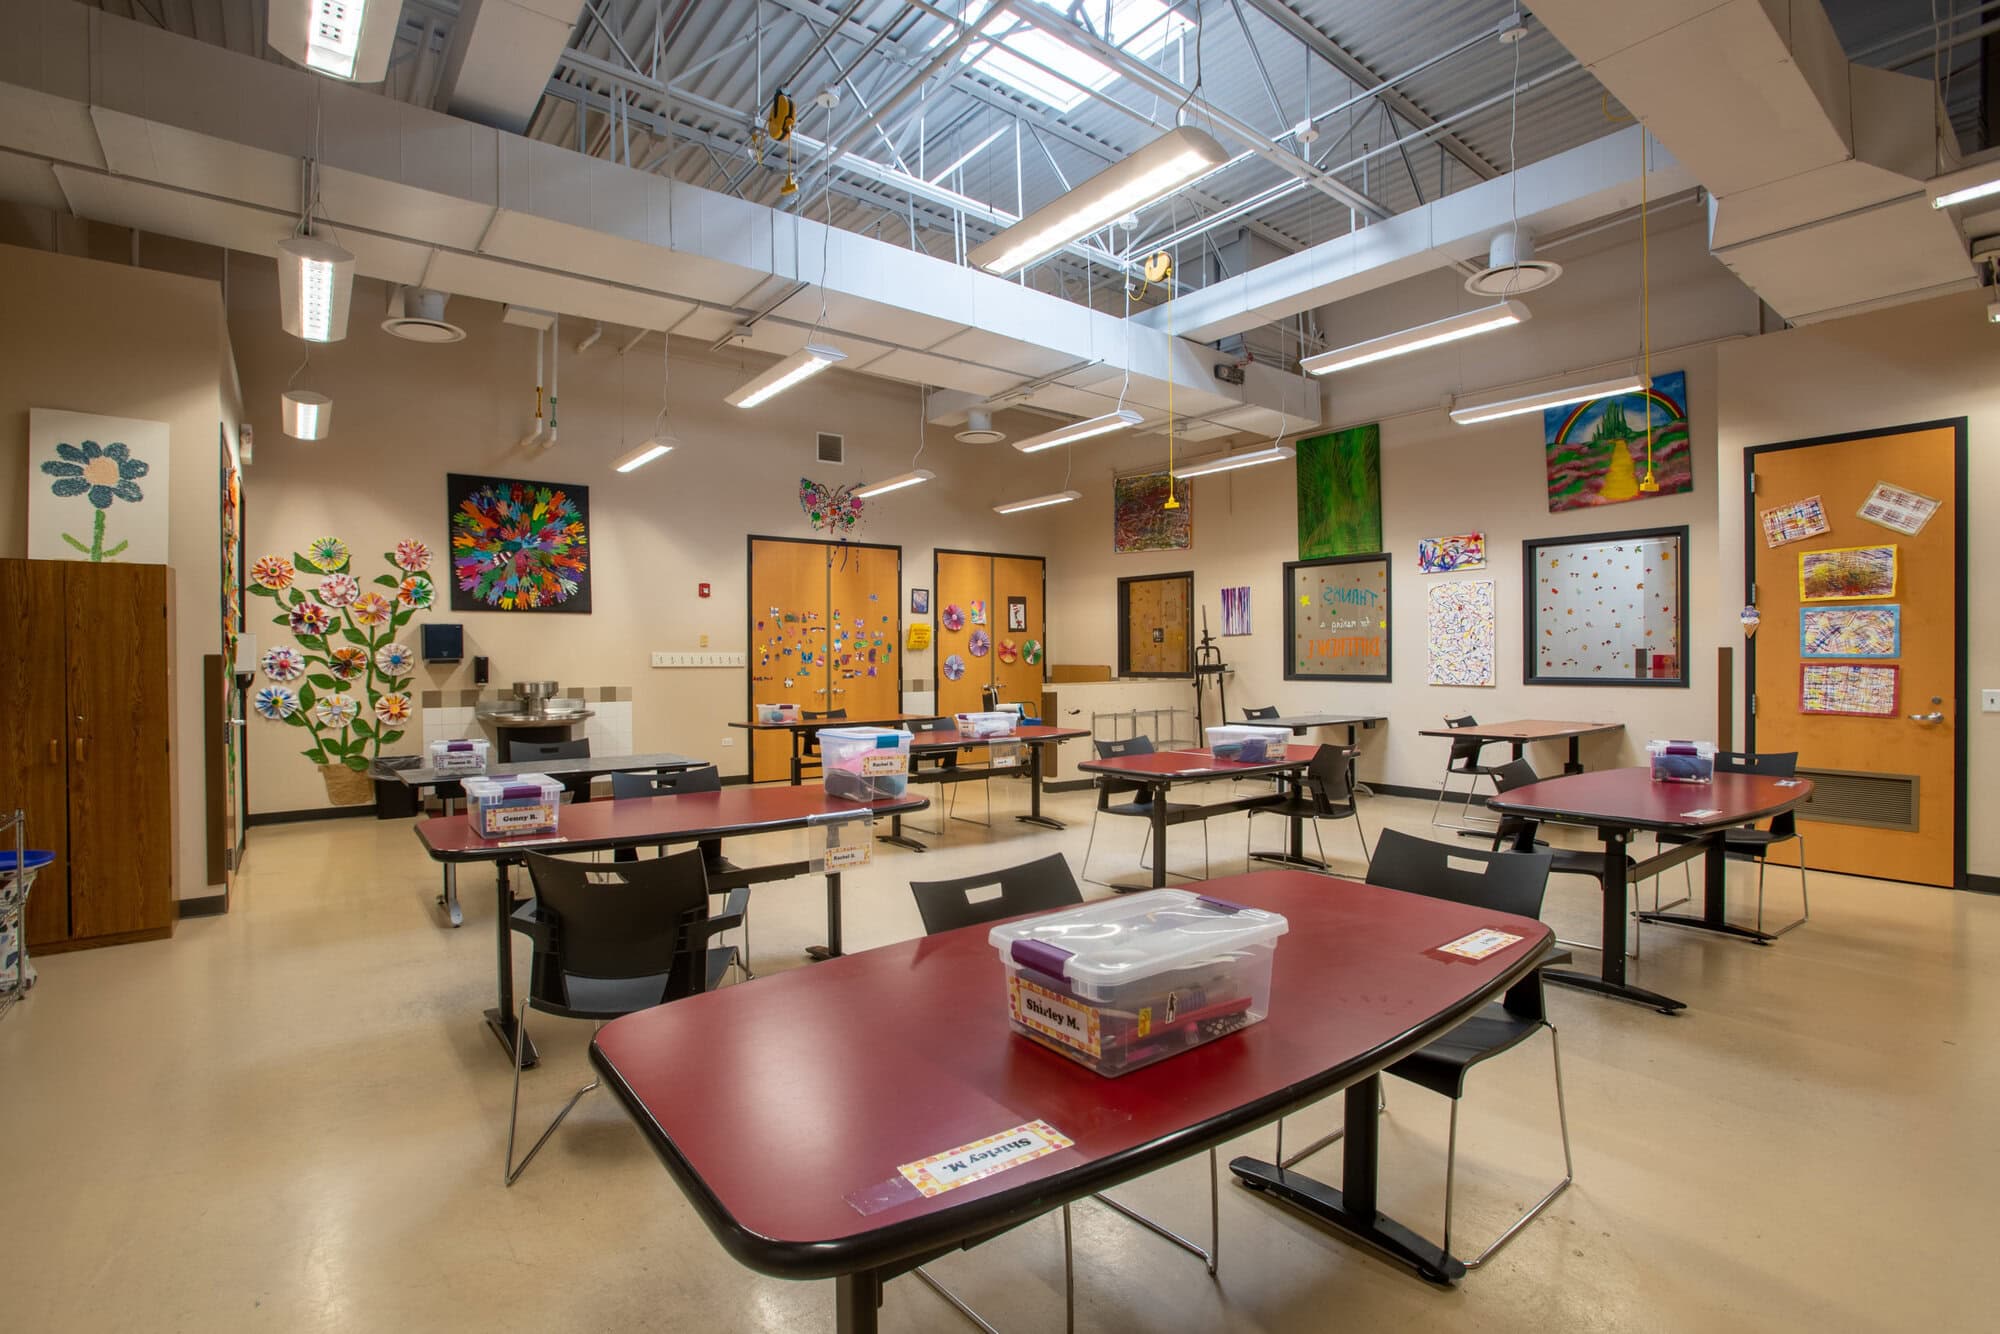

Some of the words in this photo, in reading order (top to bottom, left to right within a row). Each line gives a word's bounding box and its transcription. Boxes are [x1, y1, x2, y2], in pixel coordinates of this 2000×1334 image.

[1026, 998, 1065, 1025] Shirley
[1065, 1013, 1081, 1031] M.
[968, 1137, 1032, 1164] Shirley
[942, 1159, 967, 1173] M.
